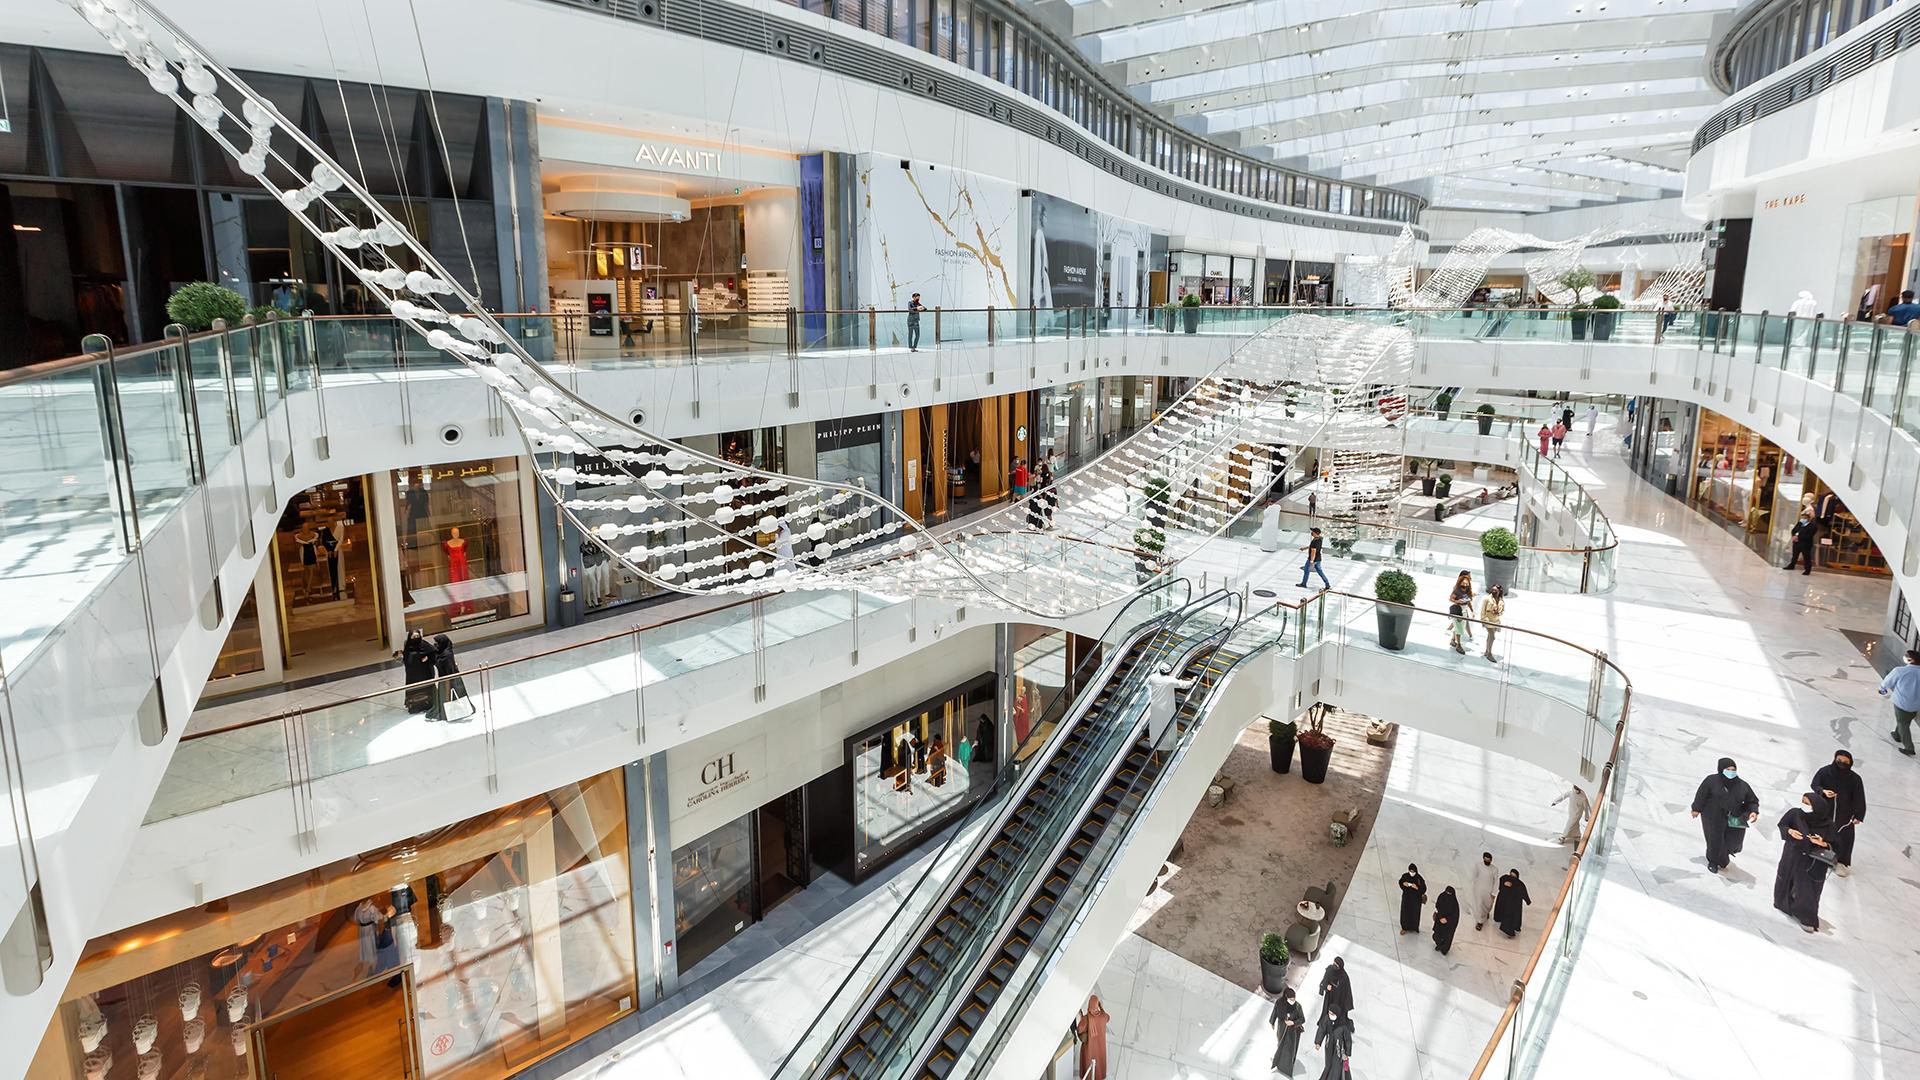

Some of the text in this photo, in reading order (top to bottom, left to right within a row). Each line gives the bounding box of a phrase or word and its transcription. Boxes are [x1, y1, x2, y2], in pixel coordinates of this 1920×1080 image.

[634, 144, 721, 172] AVANTI
[935, 248, 958, 257] FASHION
[817, 423, 881, 439] PHILIPP PLEIN
[701, 752, 735, 785] CH
[687, 788, 720, 808] CAROLINA
